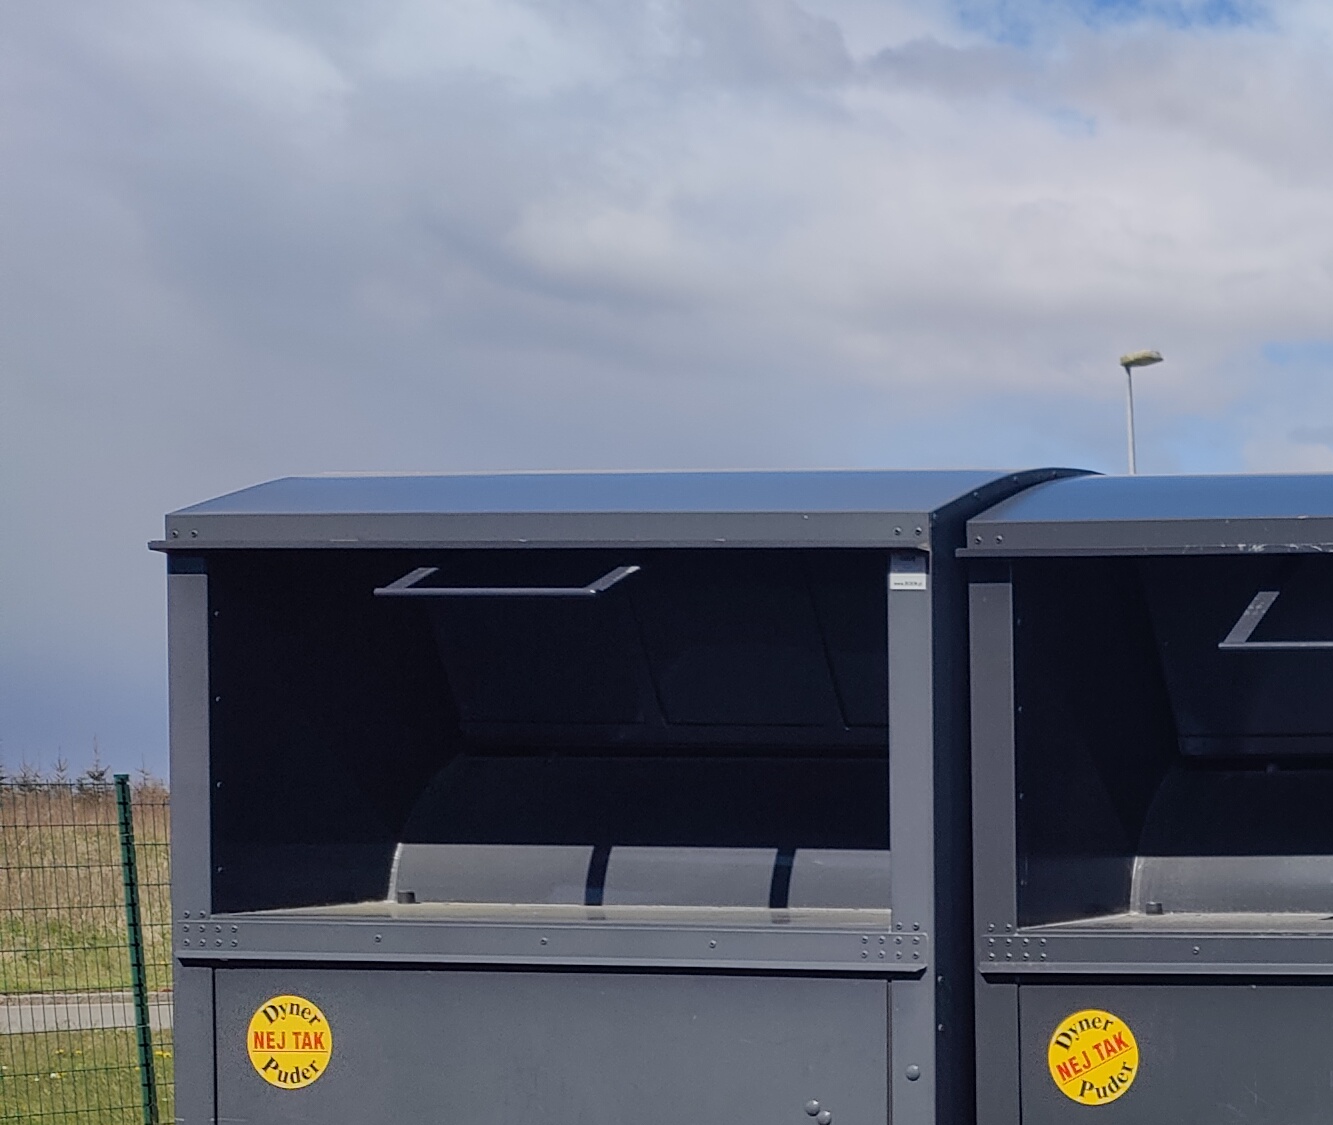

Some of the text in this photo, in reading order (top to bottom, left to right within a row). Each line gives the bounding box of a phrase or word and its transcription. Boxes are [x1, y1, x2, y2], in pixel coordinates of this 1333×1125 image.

[262, 1002, 320, 1026] Dyner
[254, 1032, 325, 1050] NEJ TAK
[1054, 1016, 1114, 1051] Dyner
[262, 1056, 320, 1084] Puder
[1056, 1031, 1130, 1081] NEJ TAK
[1078, 1062, 1134, 1098] Puder
